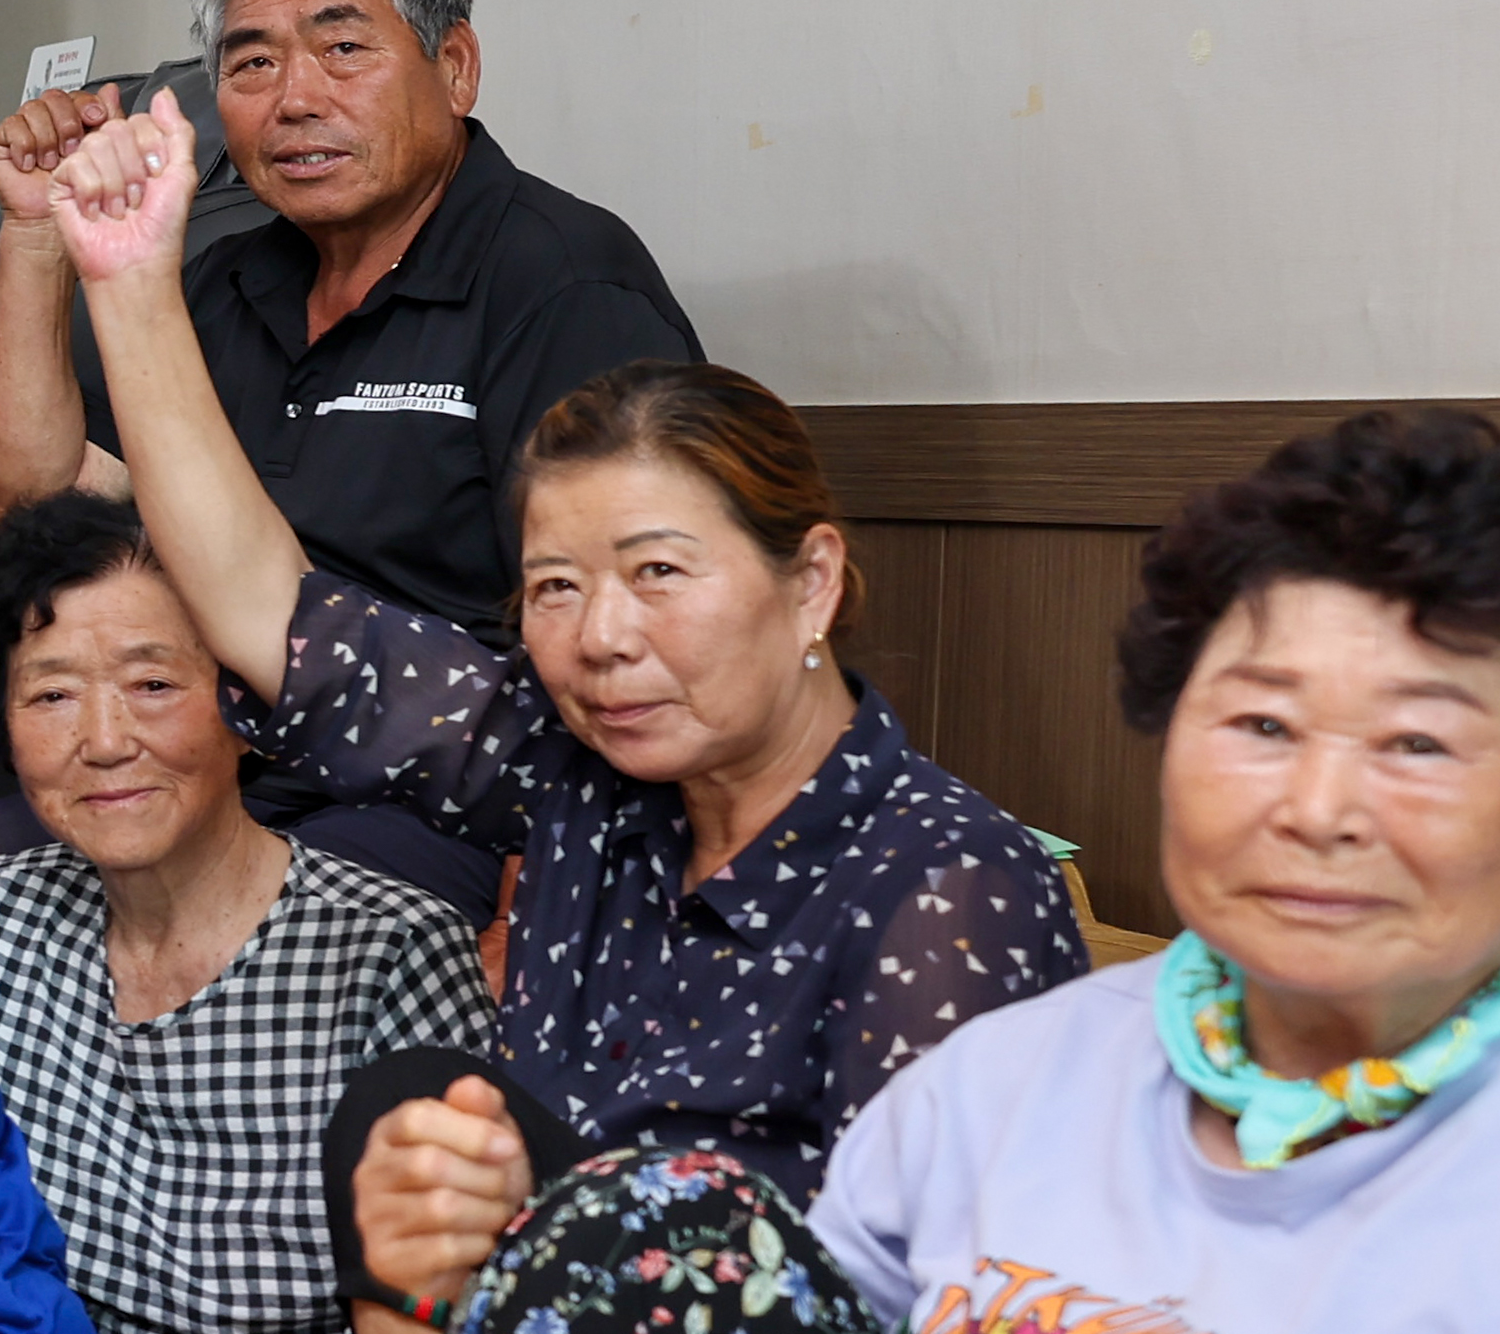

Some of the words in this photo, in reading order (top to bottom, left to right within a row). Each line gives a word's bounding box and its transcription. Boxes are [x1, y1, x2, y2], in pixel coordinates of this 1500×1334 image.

[354, 382, 405, 398] FANTOM
[406, 382, 465, 401] SPORTS
[363, 400, 417, 410] ESTABLISHED
